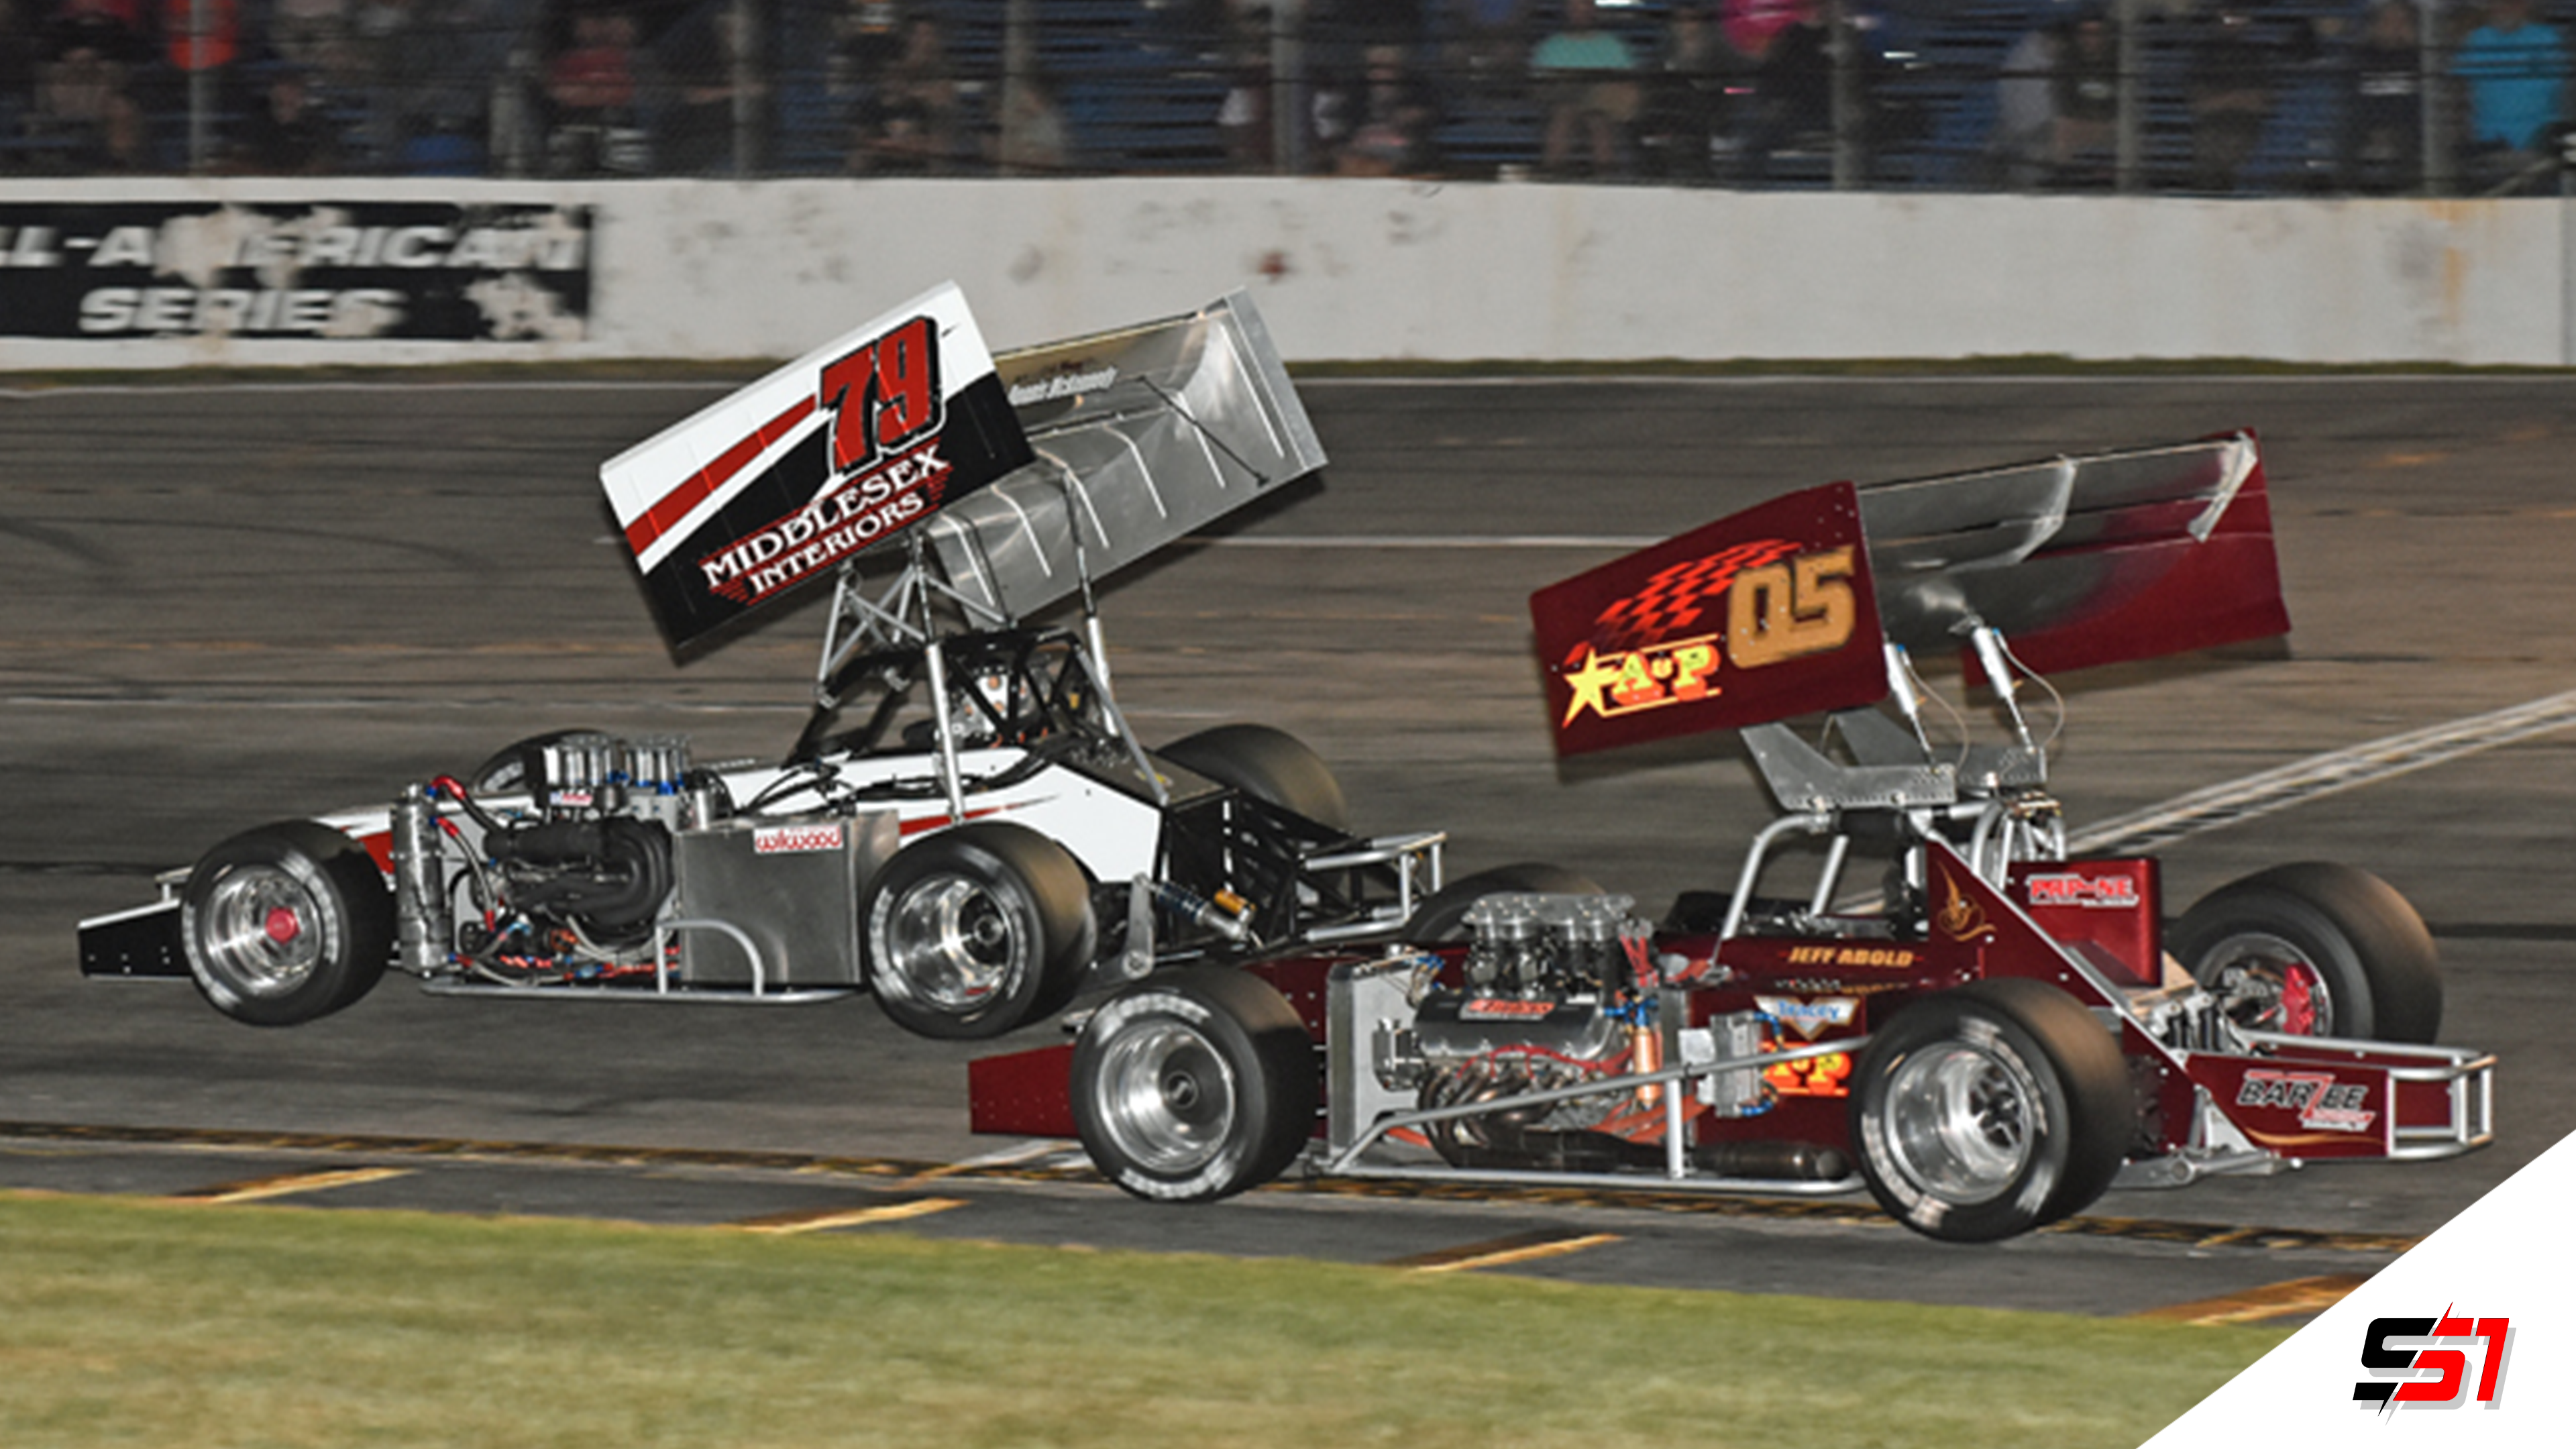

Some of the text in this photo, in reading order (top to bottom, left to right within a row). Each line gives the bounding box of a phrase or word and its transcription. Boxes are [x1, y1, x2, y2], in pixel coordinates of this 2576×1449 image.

[78, 287, 405, 335] SERIES
[820, 317, 936, 472] 79
[702, 445, 949, 588] MIDDLESEX
[750, 492, 924, 594] INTERIORS
[1727, 545, 1855, 668] 05
[1788, 947, 1915, 967] JEFF ABOLD
